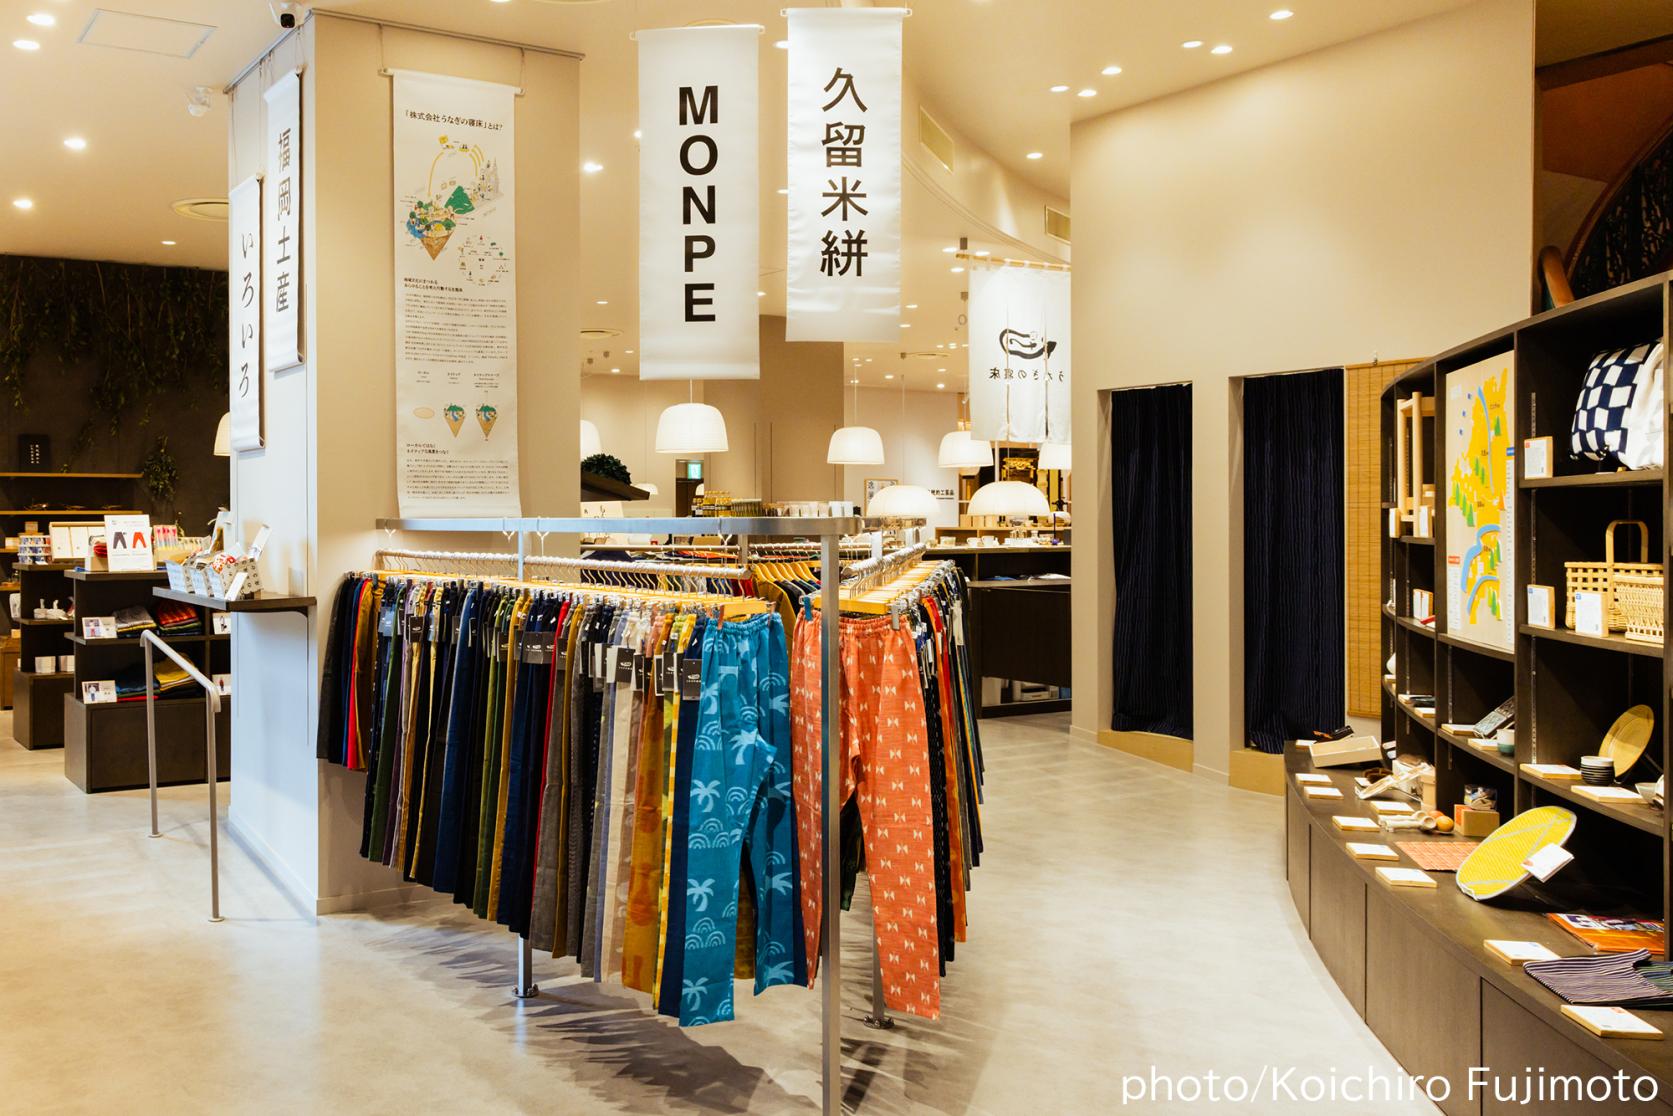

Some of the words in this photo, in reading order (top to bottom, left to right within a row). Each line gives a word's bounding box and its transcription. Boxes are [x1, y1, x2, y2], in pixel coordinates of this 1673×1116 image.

[276, 127, 291, 313] 福岡土産
[678, 85, 719, 322] MONPE
[820, 67, 869, 277] 久留米絣
[239, 232, 255, 399] いろいろ
